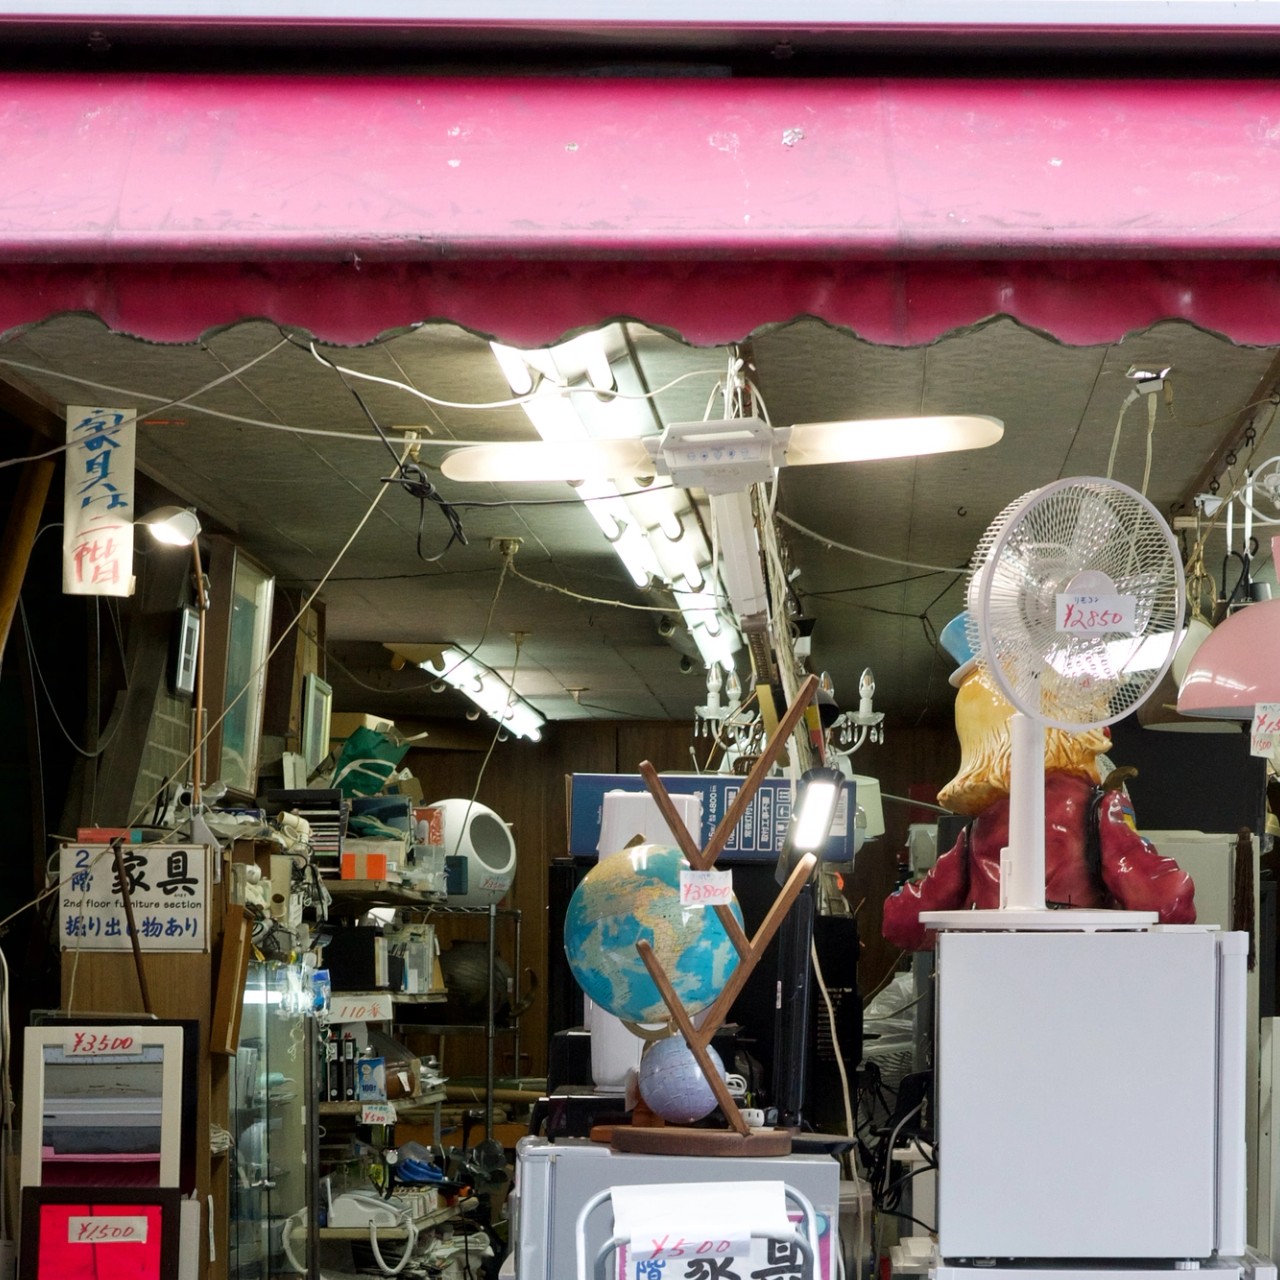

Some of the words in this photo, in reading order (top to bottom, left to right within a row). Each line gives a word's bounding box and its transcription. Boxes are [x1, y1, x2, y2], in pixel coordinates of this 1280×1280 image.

[1063, 603, 1123, 630] ¥2850
[111, 850, 199, 896] 家具
[86, 899, 111, 908] floor
[115, 899, 160, 908] funiture
[163, 899, 202, 909] section
[650, 1234, 731, 1260] ¥500
